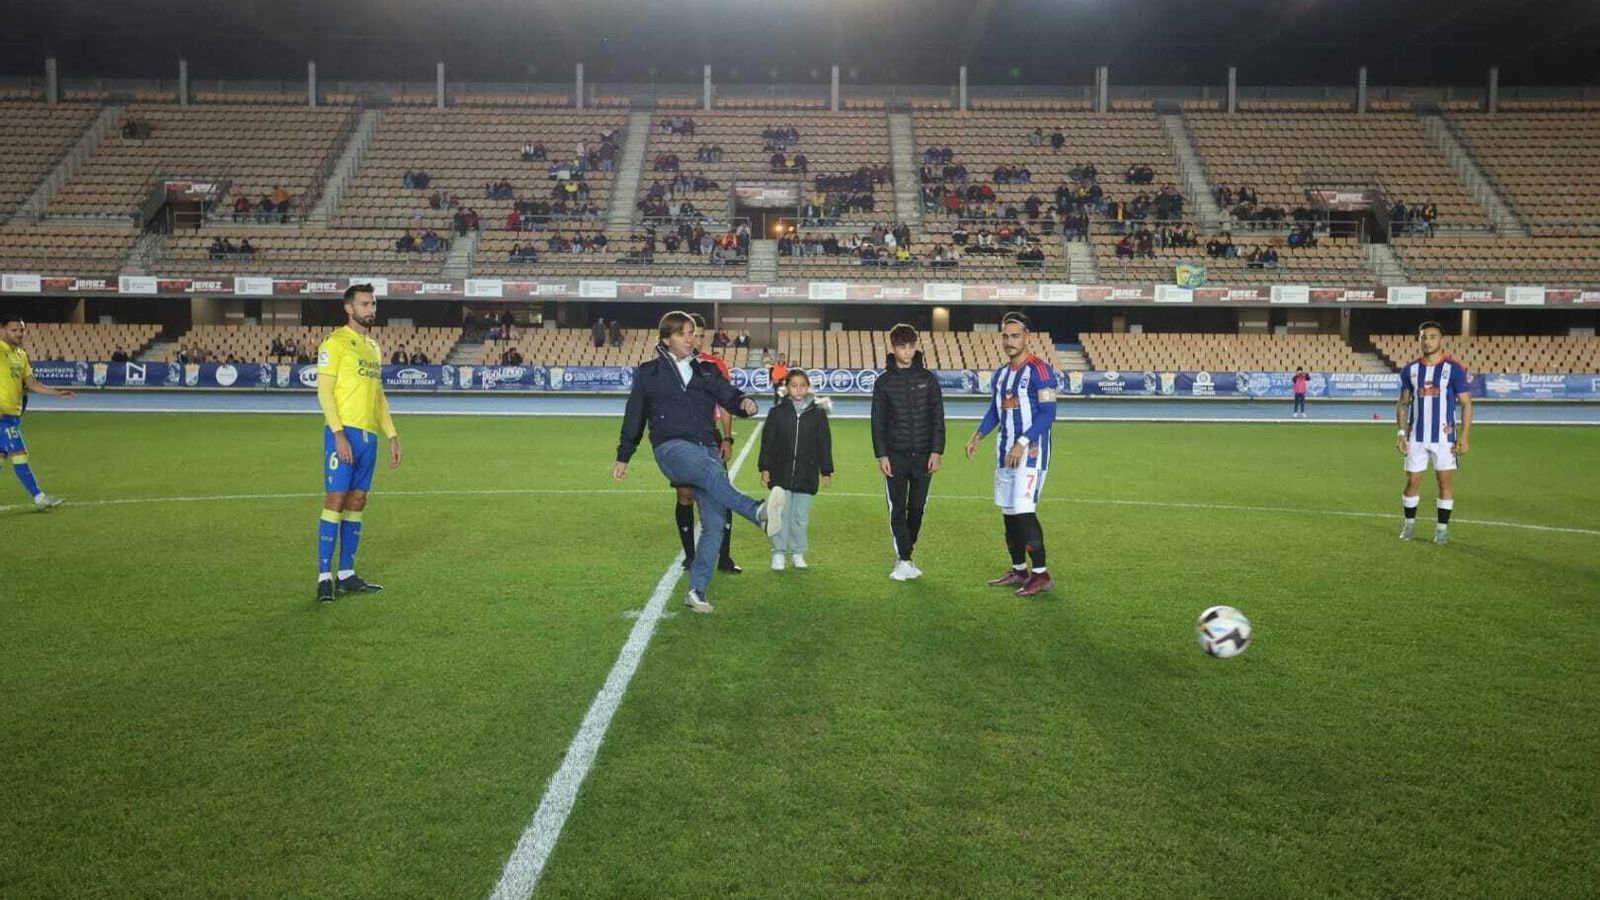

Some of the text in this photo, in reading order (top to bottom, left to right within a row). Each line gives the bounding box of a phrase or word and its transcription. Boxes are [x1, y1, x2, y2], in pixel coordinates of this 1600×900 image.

[5, 426, 19, 440] 15
[329, 451, 339, 470] 6
[1026, 474, 1036, 490] 7
